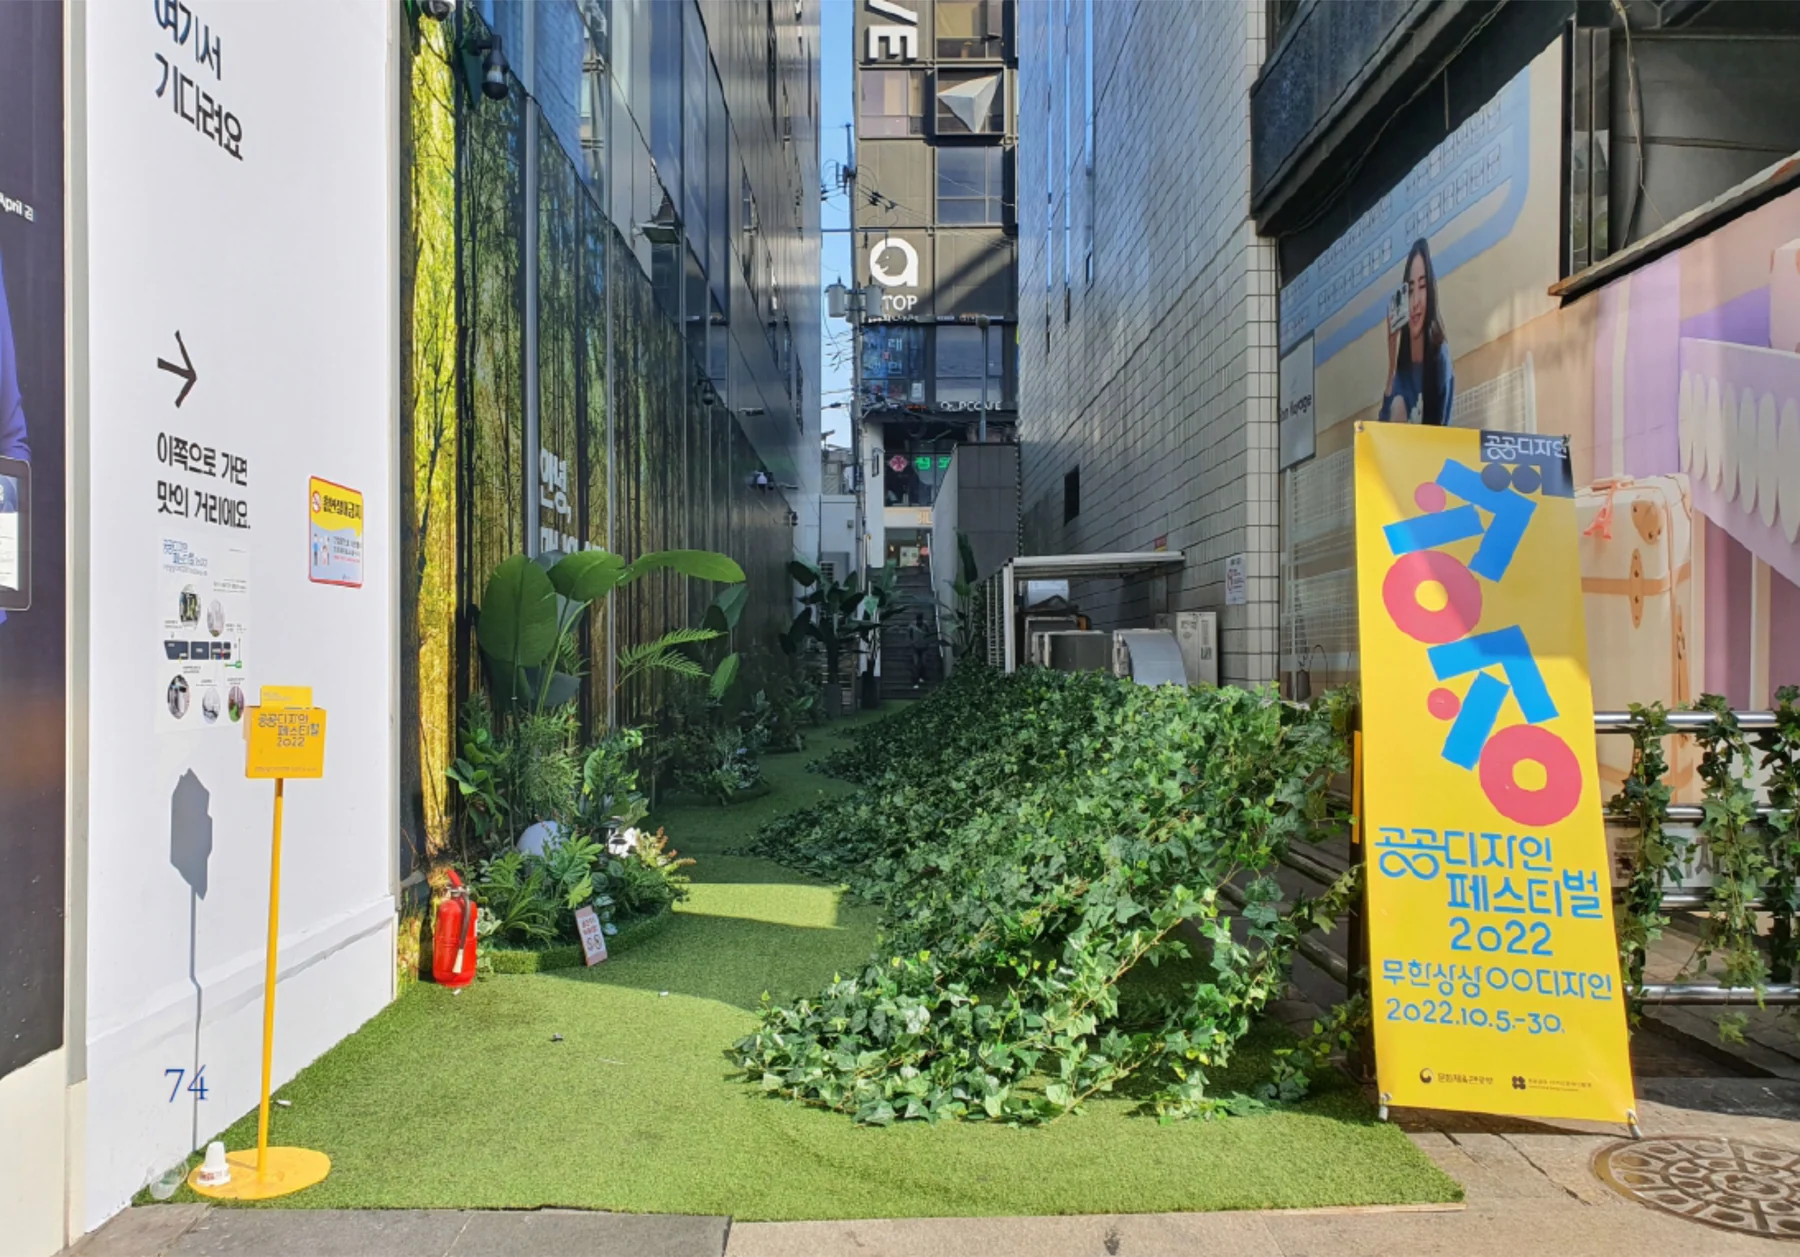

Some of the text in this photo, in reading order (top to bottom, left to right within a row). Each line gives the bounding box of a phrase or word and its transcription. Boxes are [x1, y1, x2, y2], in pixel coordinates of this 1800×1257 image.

[154, 0, 221, 81] 여기서
[154, 52, 244, 162] 기다려요
[157, 431, 248, 487] 이쪽으로 가면
[1484, 435, 1567, 461] 공공디자인
[157, 479, 251, 529] 맛의 거리에요.
[277, 736, 305, 748] 2022
[1374, 827, 1553, 880] 공공디자인
[1446, 868, 1603, 919] 페스티벌
[1449, 916, 1553, 956] 2022
[164, 1063, 209, 1103] 74
